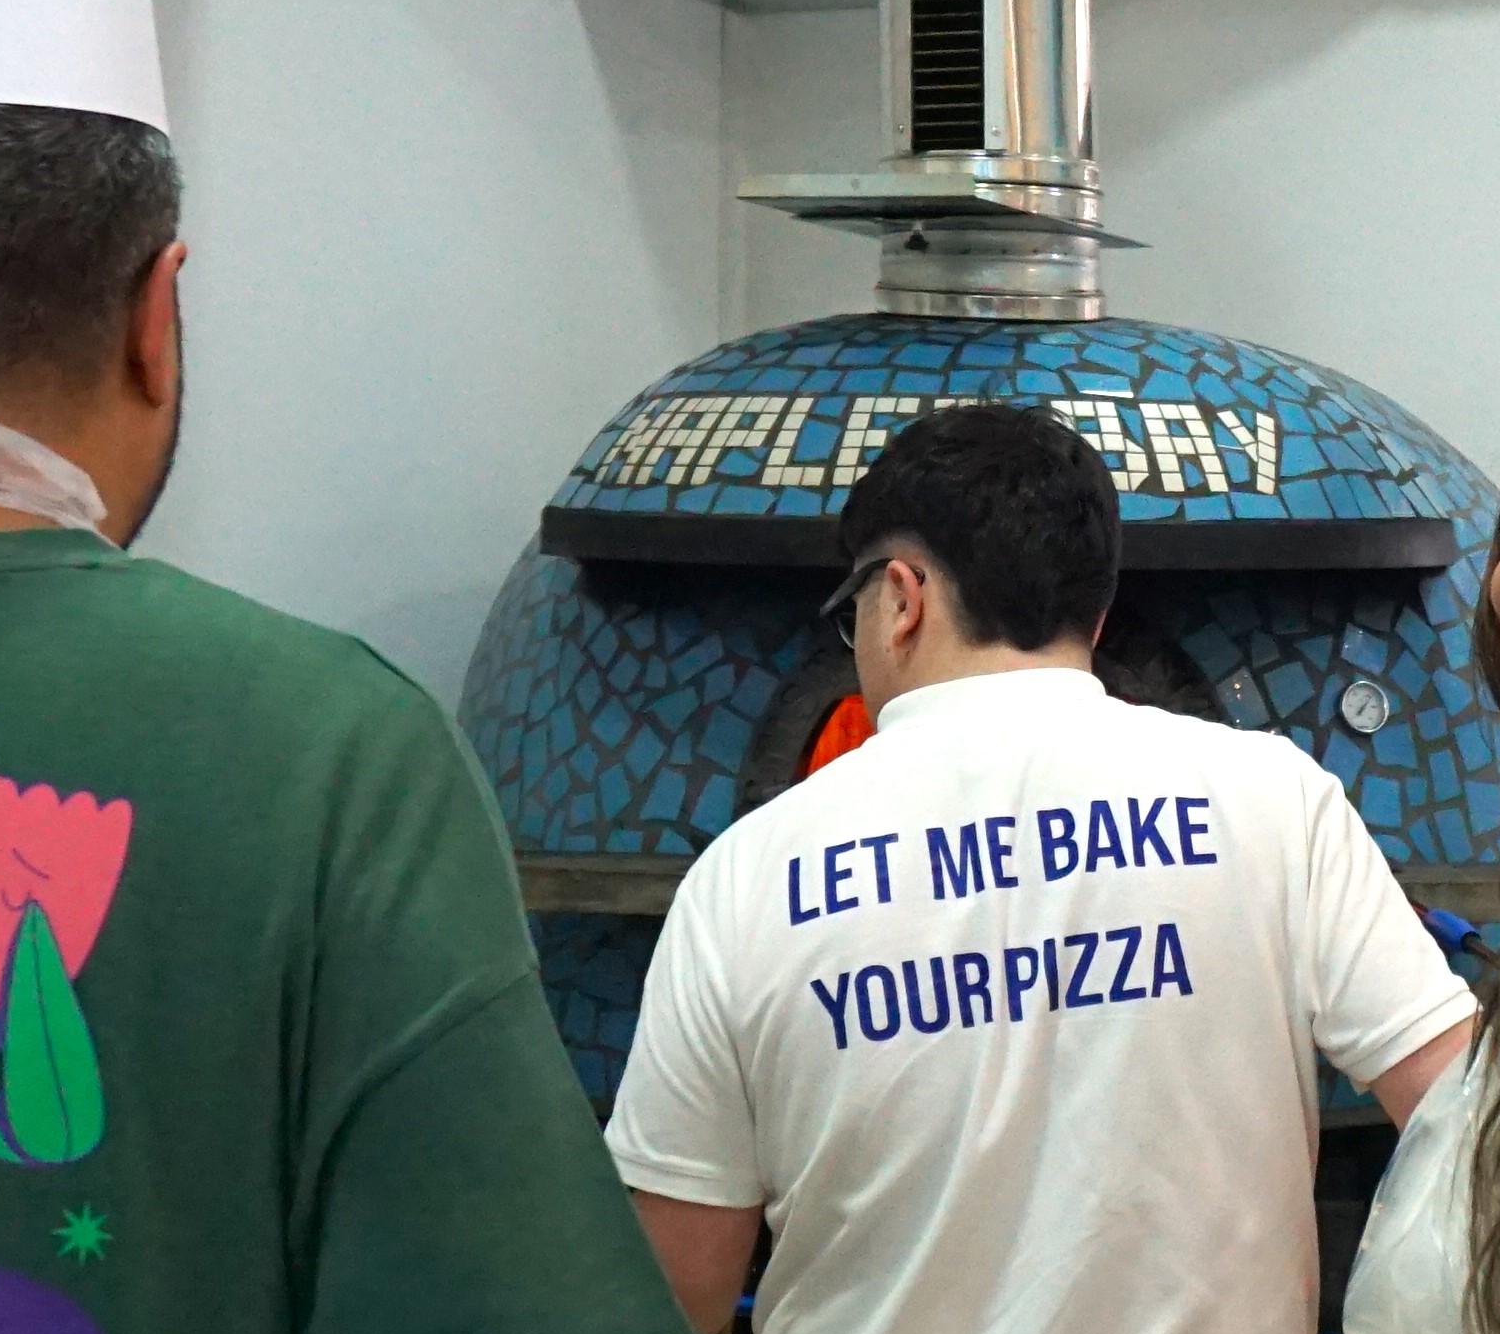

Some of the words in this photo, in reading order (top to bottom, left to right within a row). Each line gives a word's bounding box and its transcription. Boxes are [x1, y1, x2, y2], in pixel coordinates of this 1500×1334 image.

[594, 396, 1003, 486] NAPLE
[788, 832, 898, 926] LET
[925, 816, 1018, 901] ME
[1036, 796, 1218, 882] BAKE
[810, 952, 993, 1050] YOUR
[1003, 922, 1194, 1023] PIZZA
